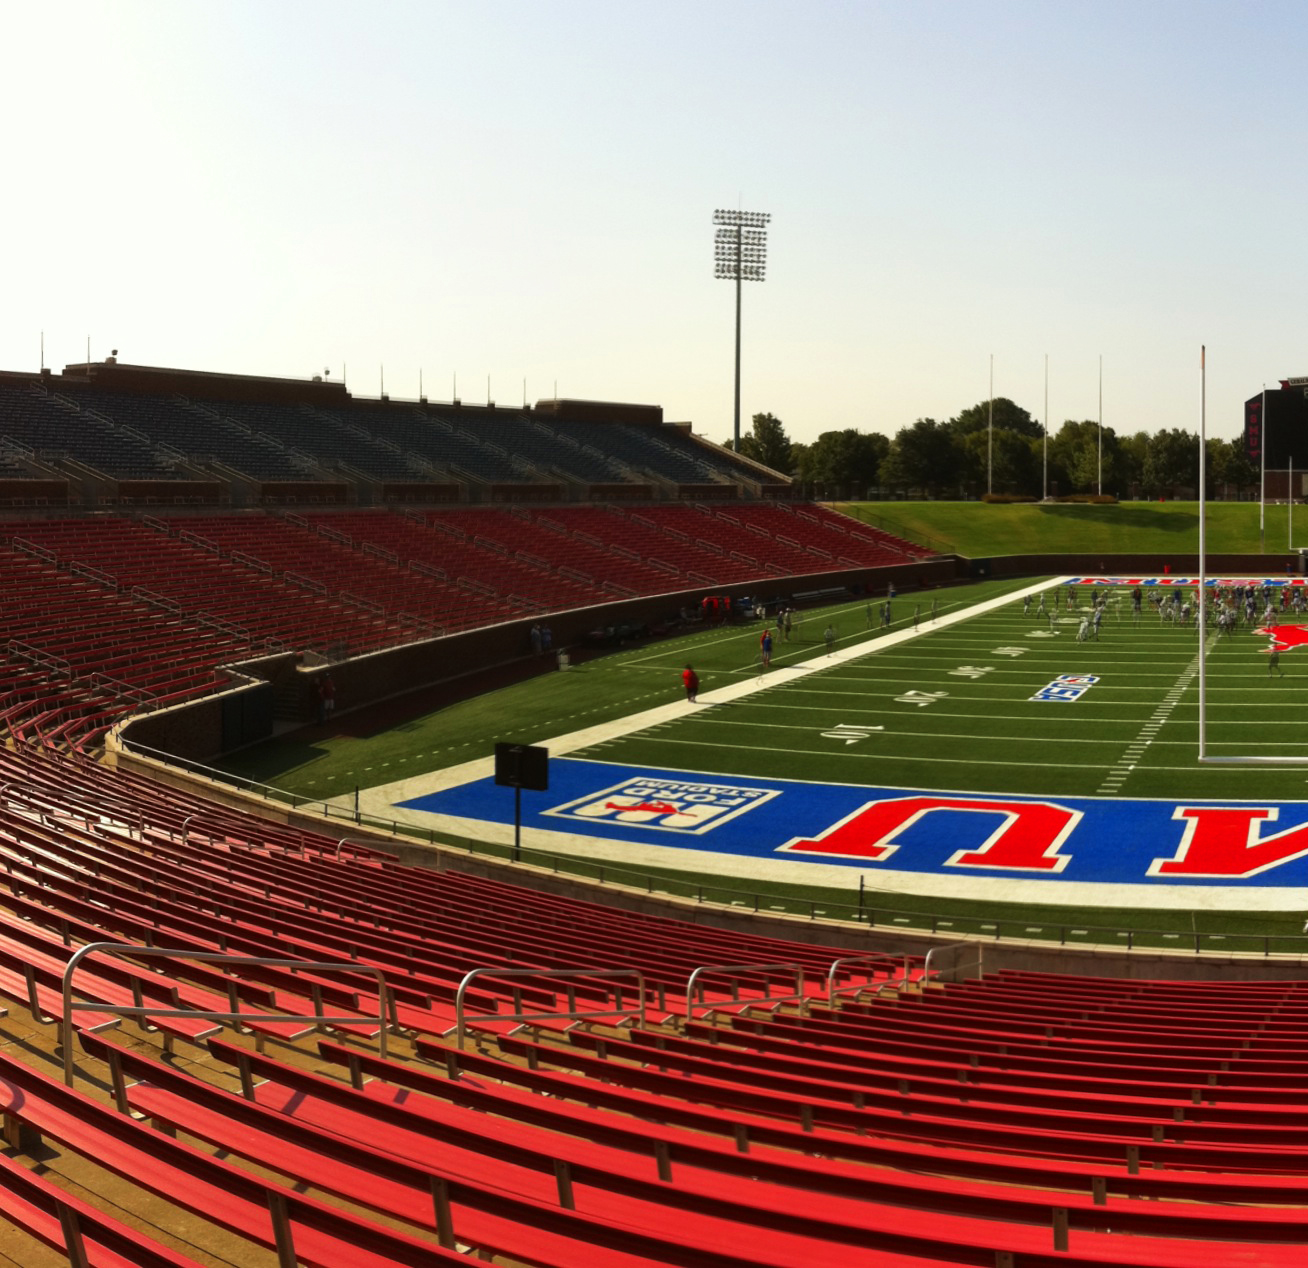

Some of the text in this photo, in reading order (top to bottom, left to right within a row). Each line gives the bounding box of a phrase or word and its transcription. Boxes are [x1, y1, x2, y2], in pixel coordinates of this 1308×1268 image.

[1249, 414, 1259, 447] SMU
[820, 723, 885, 739] 10
[623, 787, 747, 806] FORD
[635, 780, 762, 798] STADIUM
